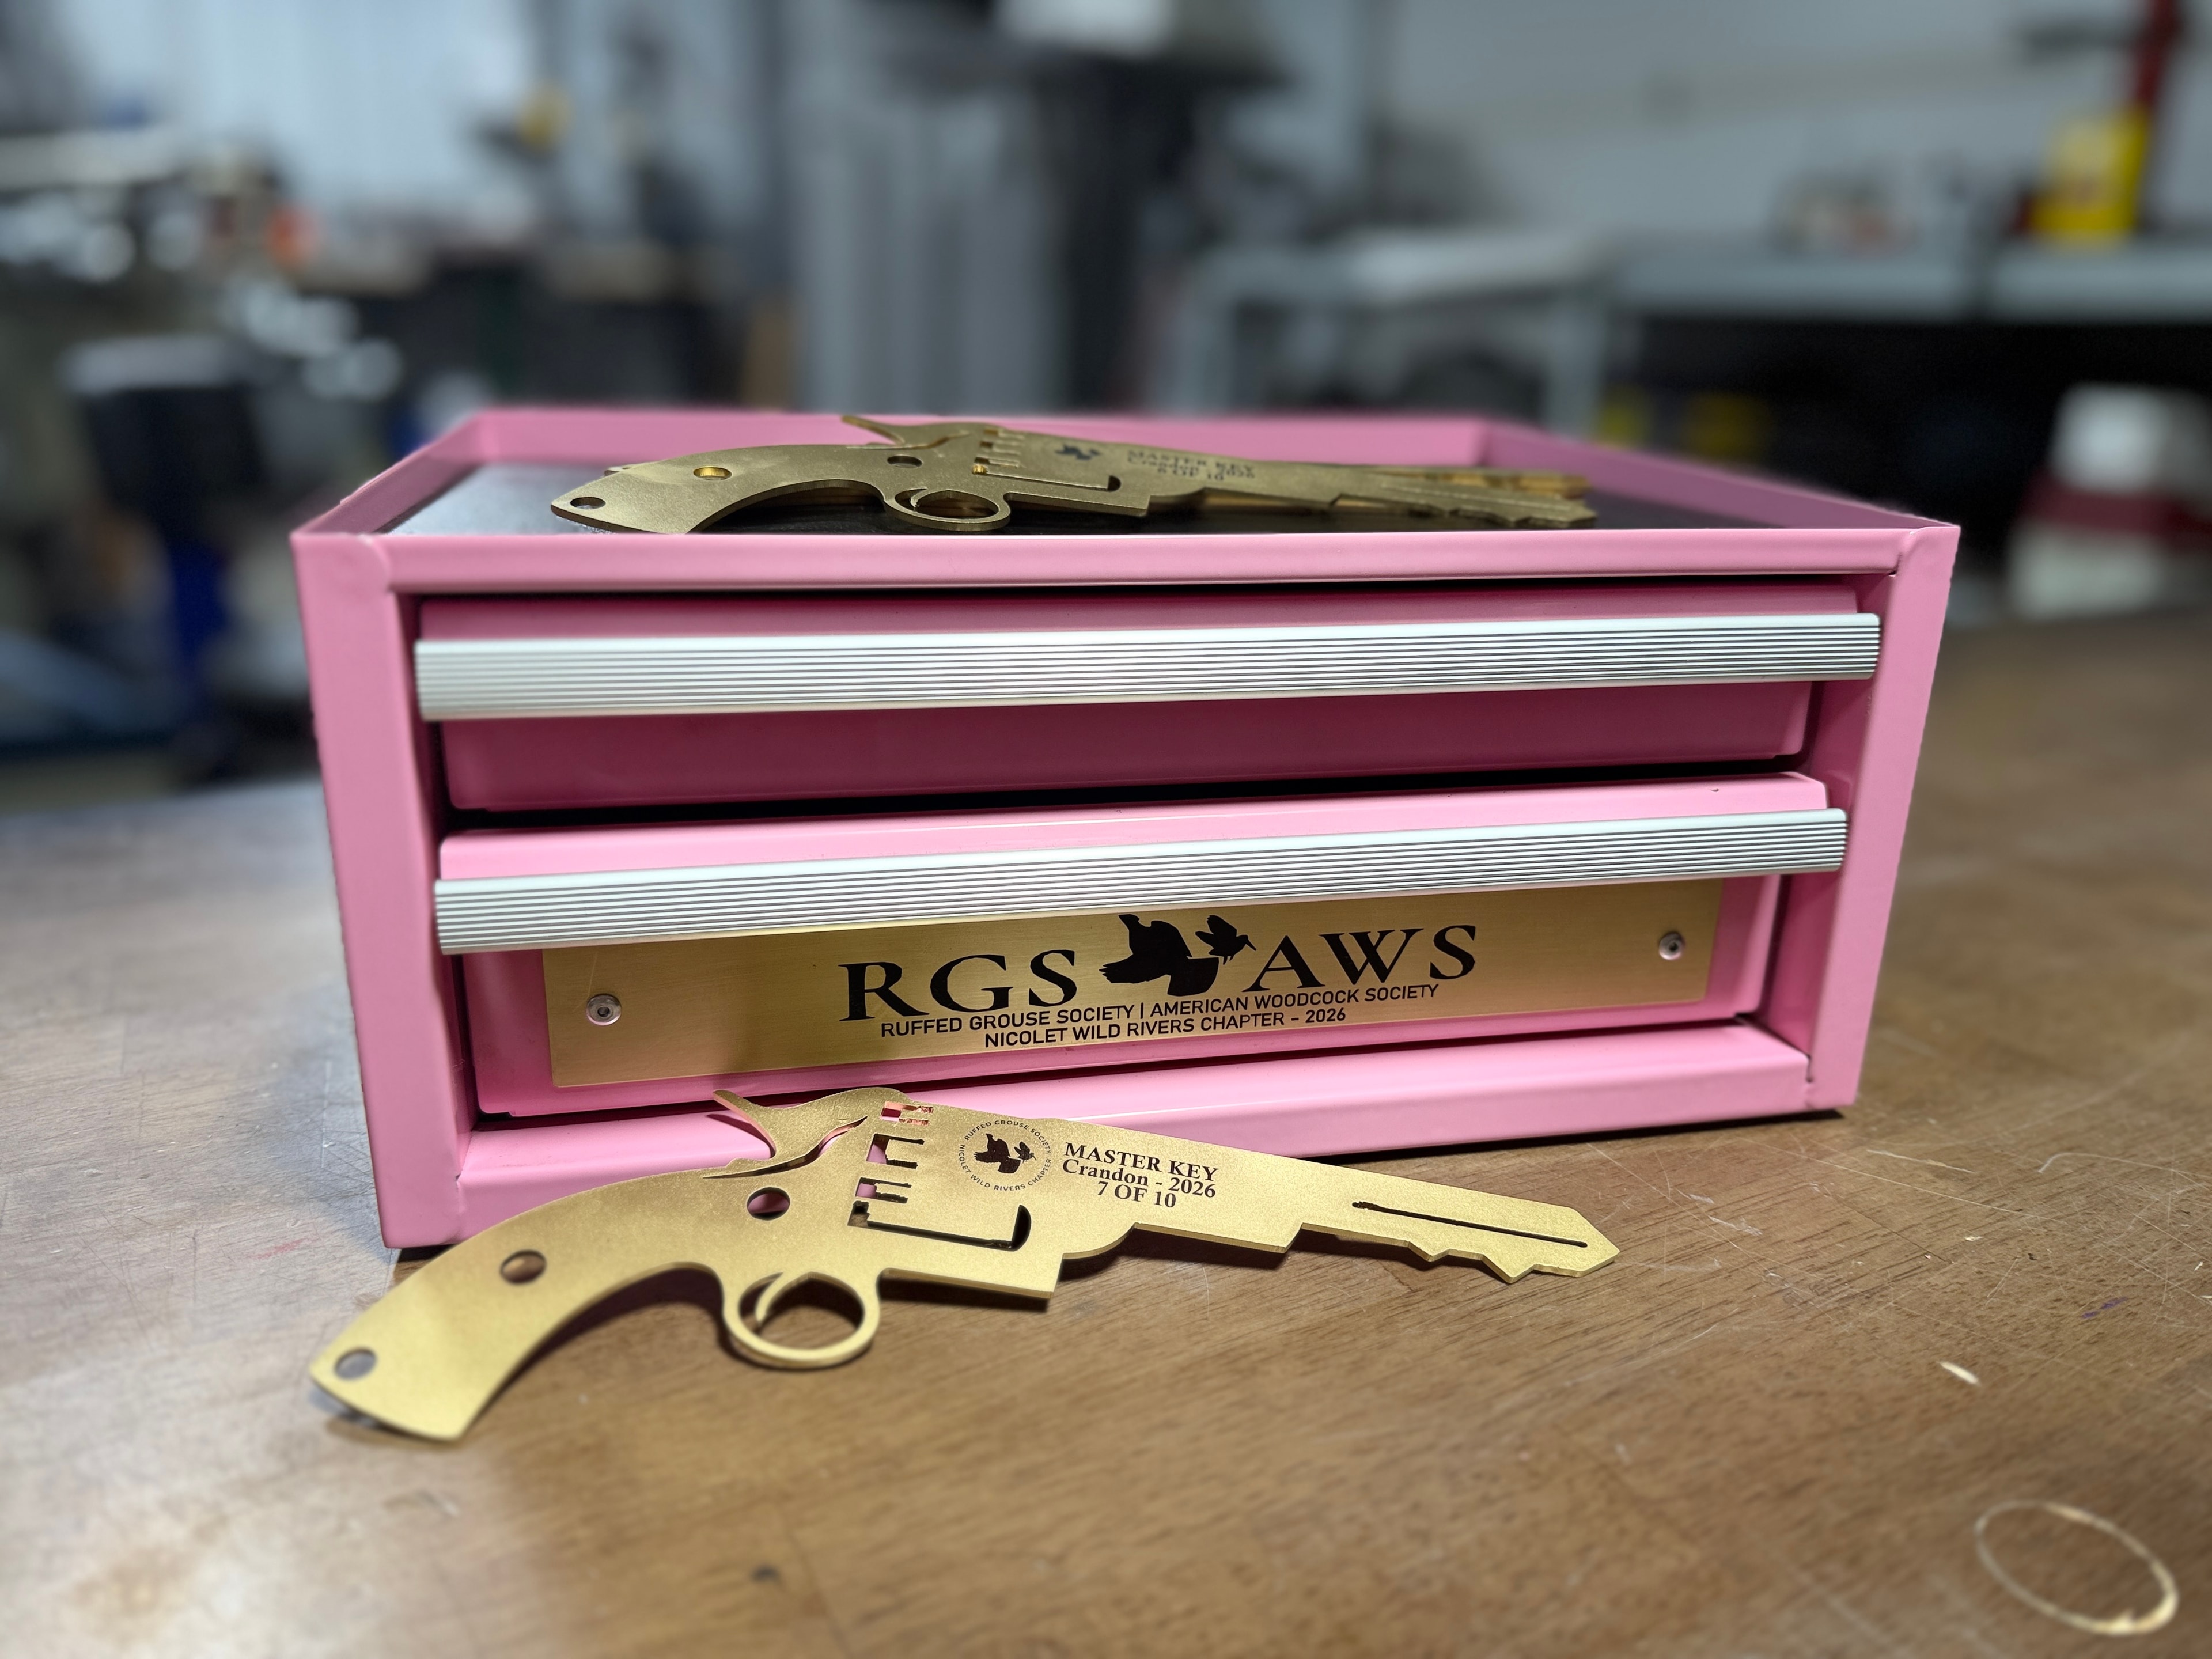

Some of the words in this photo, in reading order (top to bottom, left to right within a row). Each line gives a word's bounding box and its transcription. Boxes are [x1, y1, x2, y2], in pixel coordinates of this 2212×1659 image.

[838, 949, 1078, 1022] RGS
[1242, 925, 1476, 993] AWS
[881, 1017, 963, 1037] RUFFED
[969, 1010, 1051, 1031] GROUSE
[1057, 1004, 1135, 1024] SOCIETY
[1150, 996, 1248, 1017] AMERICAN
[1255, 988, 1359, 1009] WOODCOCK
[1364, 983, 1439, 1002] SOCIETY
[985, 1028, 1068, 1048] NICOLET
[1073, 1024, 1120, 1041] WILD
[1127, 1018, 1195, 1036] RIVERS
[1200, 1012, 1285, 1031] CHAPTER
[1305, 1007, 1346, 1024] 2026
[964, 1122, 992, 1141] RUFFED
[994, 1120, 1029, 1130] GROUSE
[1030, 1128, 1052, 1155] SOCIETY
[959, 1144, 972, 1173] NICOLET
[970, 1174, 991, 1188] WILD
[1028, 1159, 1052, 1186] CHAPTER
[1062, 1159, 1149, 1187] Crandon
[1168, 1177, 1216, 1198] 2026
[1064, 1142, 1162, 1172] MASTER
[1168, 1160, 1219, 1181] KEY
[1097, 1181, 1108, 1195] 7
[1114, 1184, 1147, 1202] OF
[1154, 1191, 1176, 1208] 10
